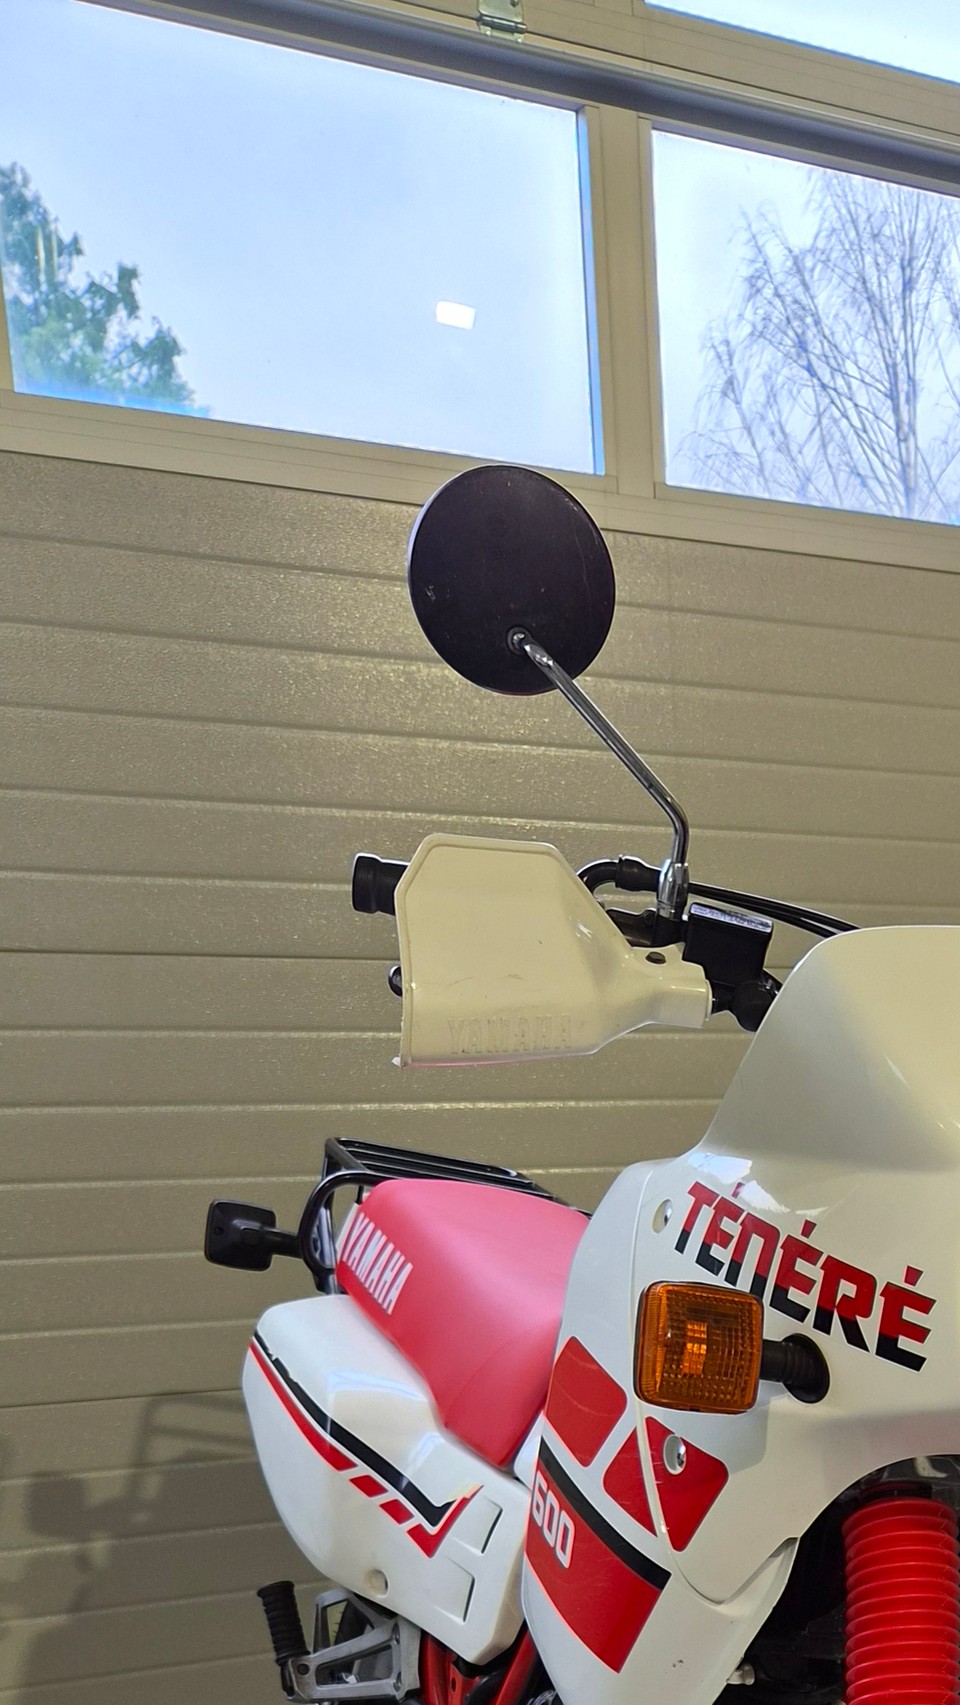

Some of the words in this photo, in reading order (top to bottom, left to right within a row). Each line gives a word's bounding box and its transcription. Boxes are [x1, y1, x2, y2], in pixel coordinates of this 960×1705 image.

[342, 1212, 413, 1315] YAMAHA
[675, 1181, 937, 1372] TÉNÉRÉ
[532, 1470, 575, 1568] 600
